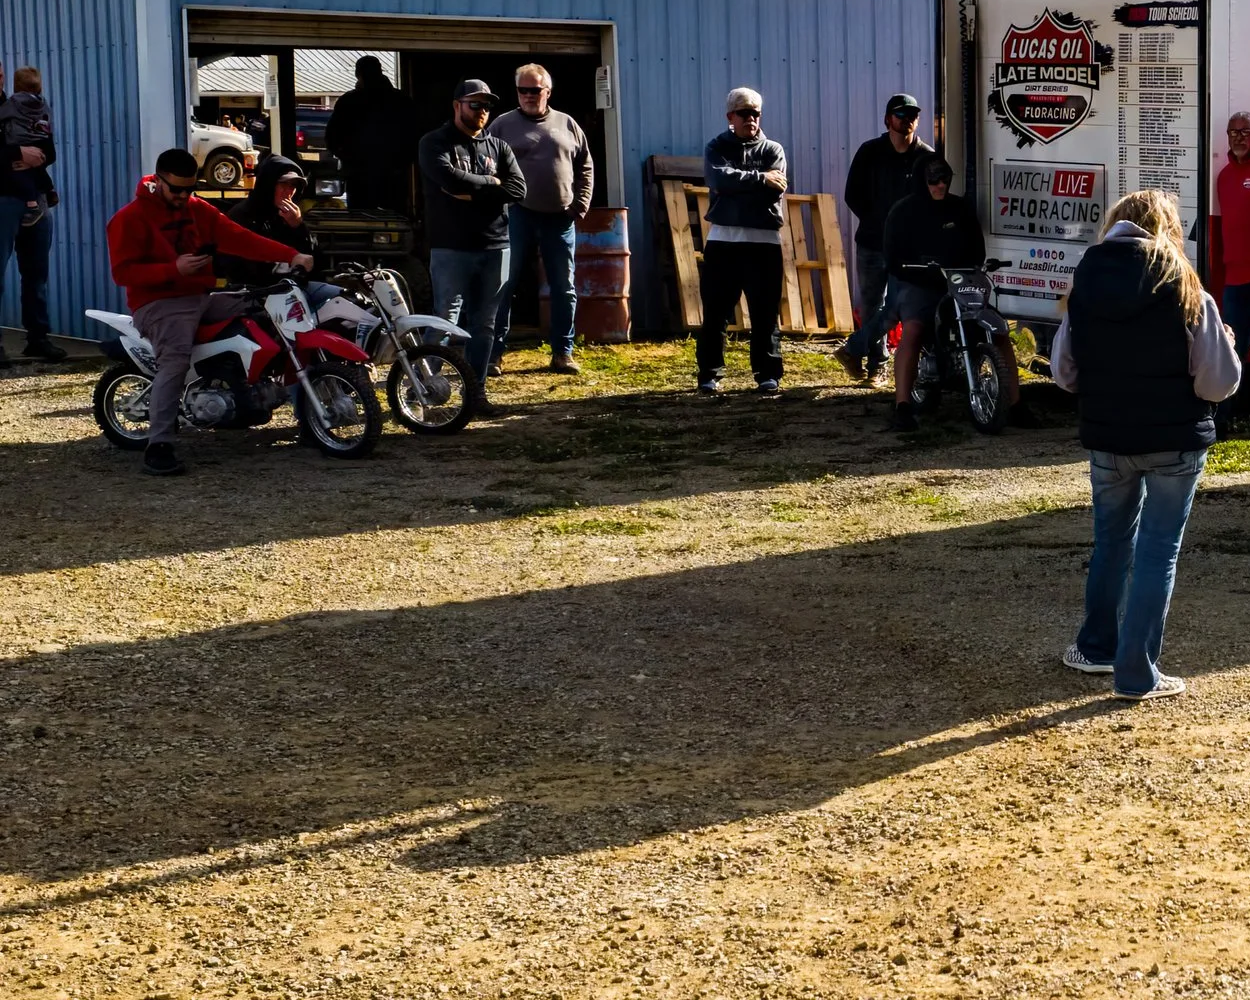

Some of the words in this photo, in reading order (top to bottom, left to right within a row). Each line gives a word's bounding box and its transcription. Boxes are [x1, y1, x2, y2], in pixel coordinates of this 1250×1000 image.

[1148, 7, 1168, 21] TOUR
[1010, 38, 1057, 59] LUCAS
[1060, 38, 1083, 59] OIL
[998, 66, 1037, 84] LATE
[1040, 66, 1097, 86] MODEL
[1042, 85, 1069, 93] SERIES
[1024, 106, 1076, 120] FLORACING
[1003, 170, 1051, 192] WATCH
[1058, 174, 1089, 195] LIVE
[1009, 198, 1100, 223] FLORACING
